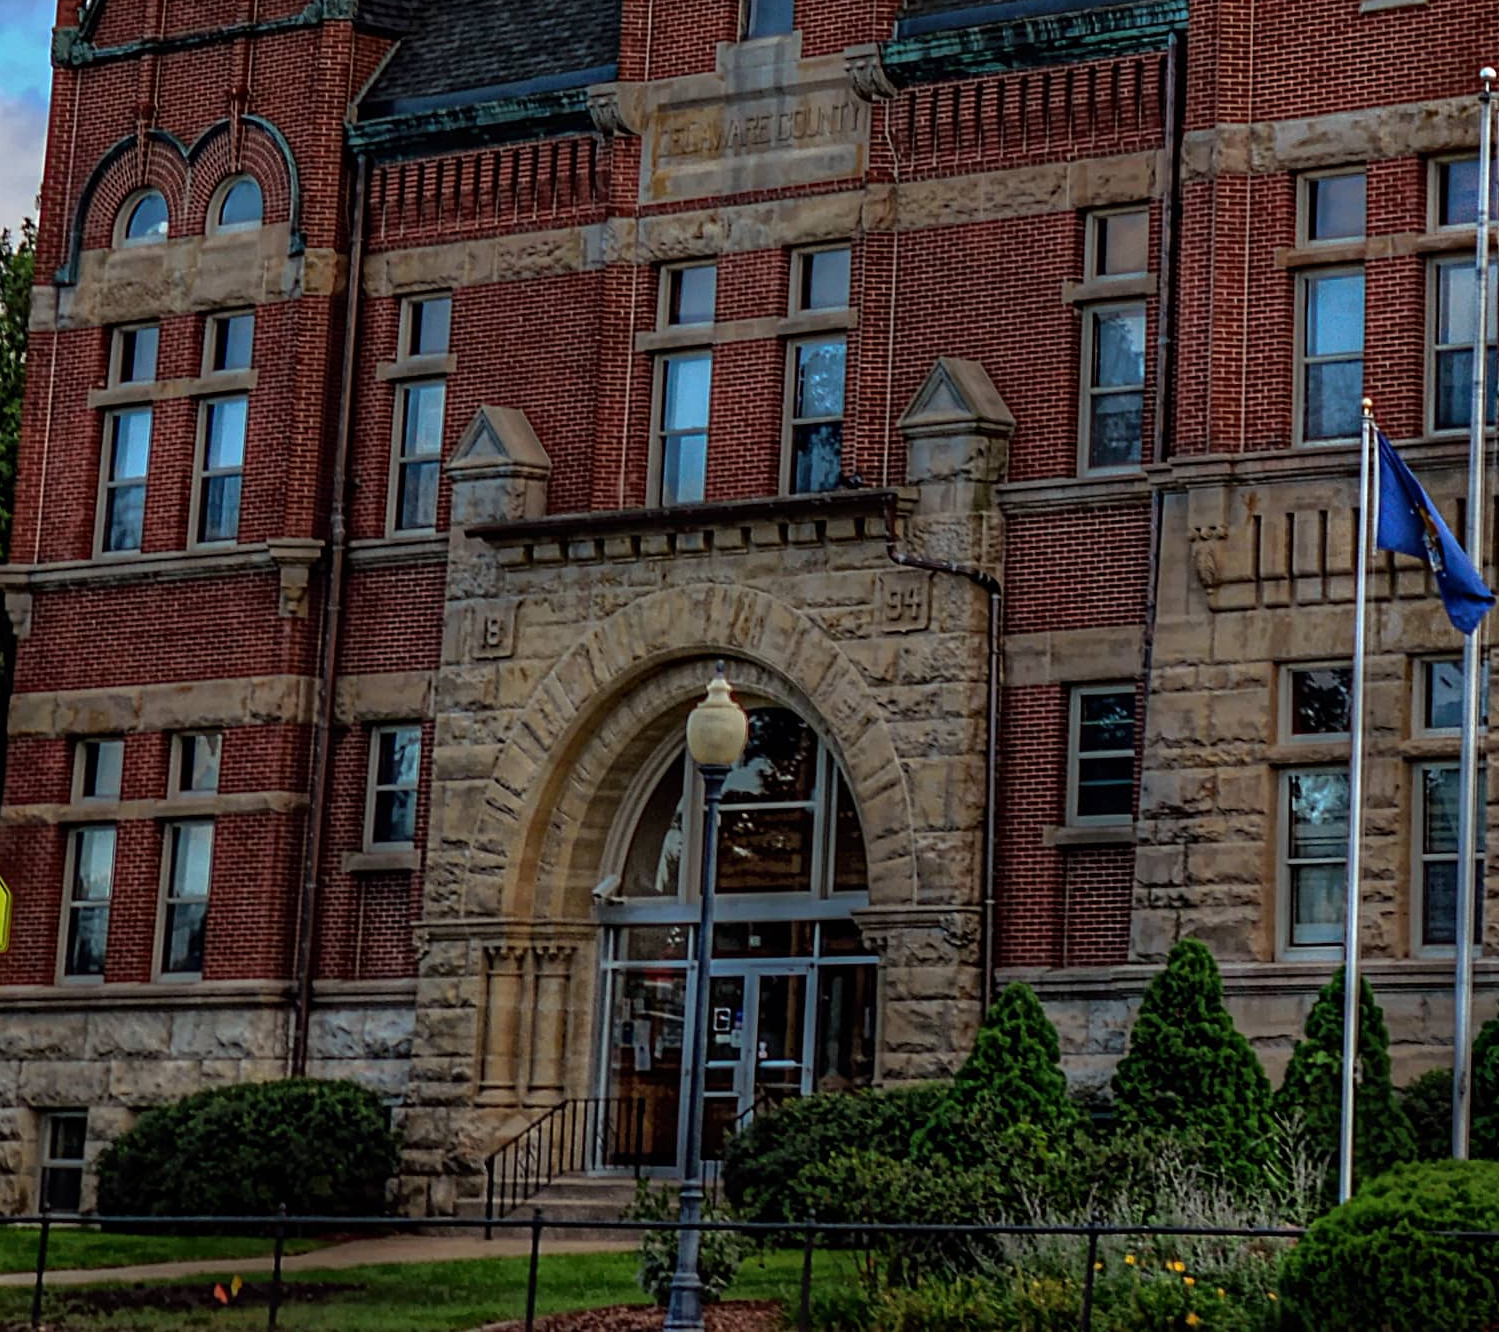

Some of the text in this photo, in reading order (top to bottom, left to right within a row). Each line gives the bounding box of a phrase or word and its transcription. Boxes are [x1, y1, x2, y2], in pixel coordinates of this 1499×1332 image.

[778, 102, 860, 142] COUNTY
[887, 588, 921, 622] 94
[482, 616, 503, 648] 18
